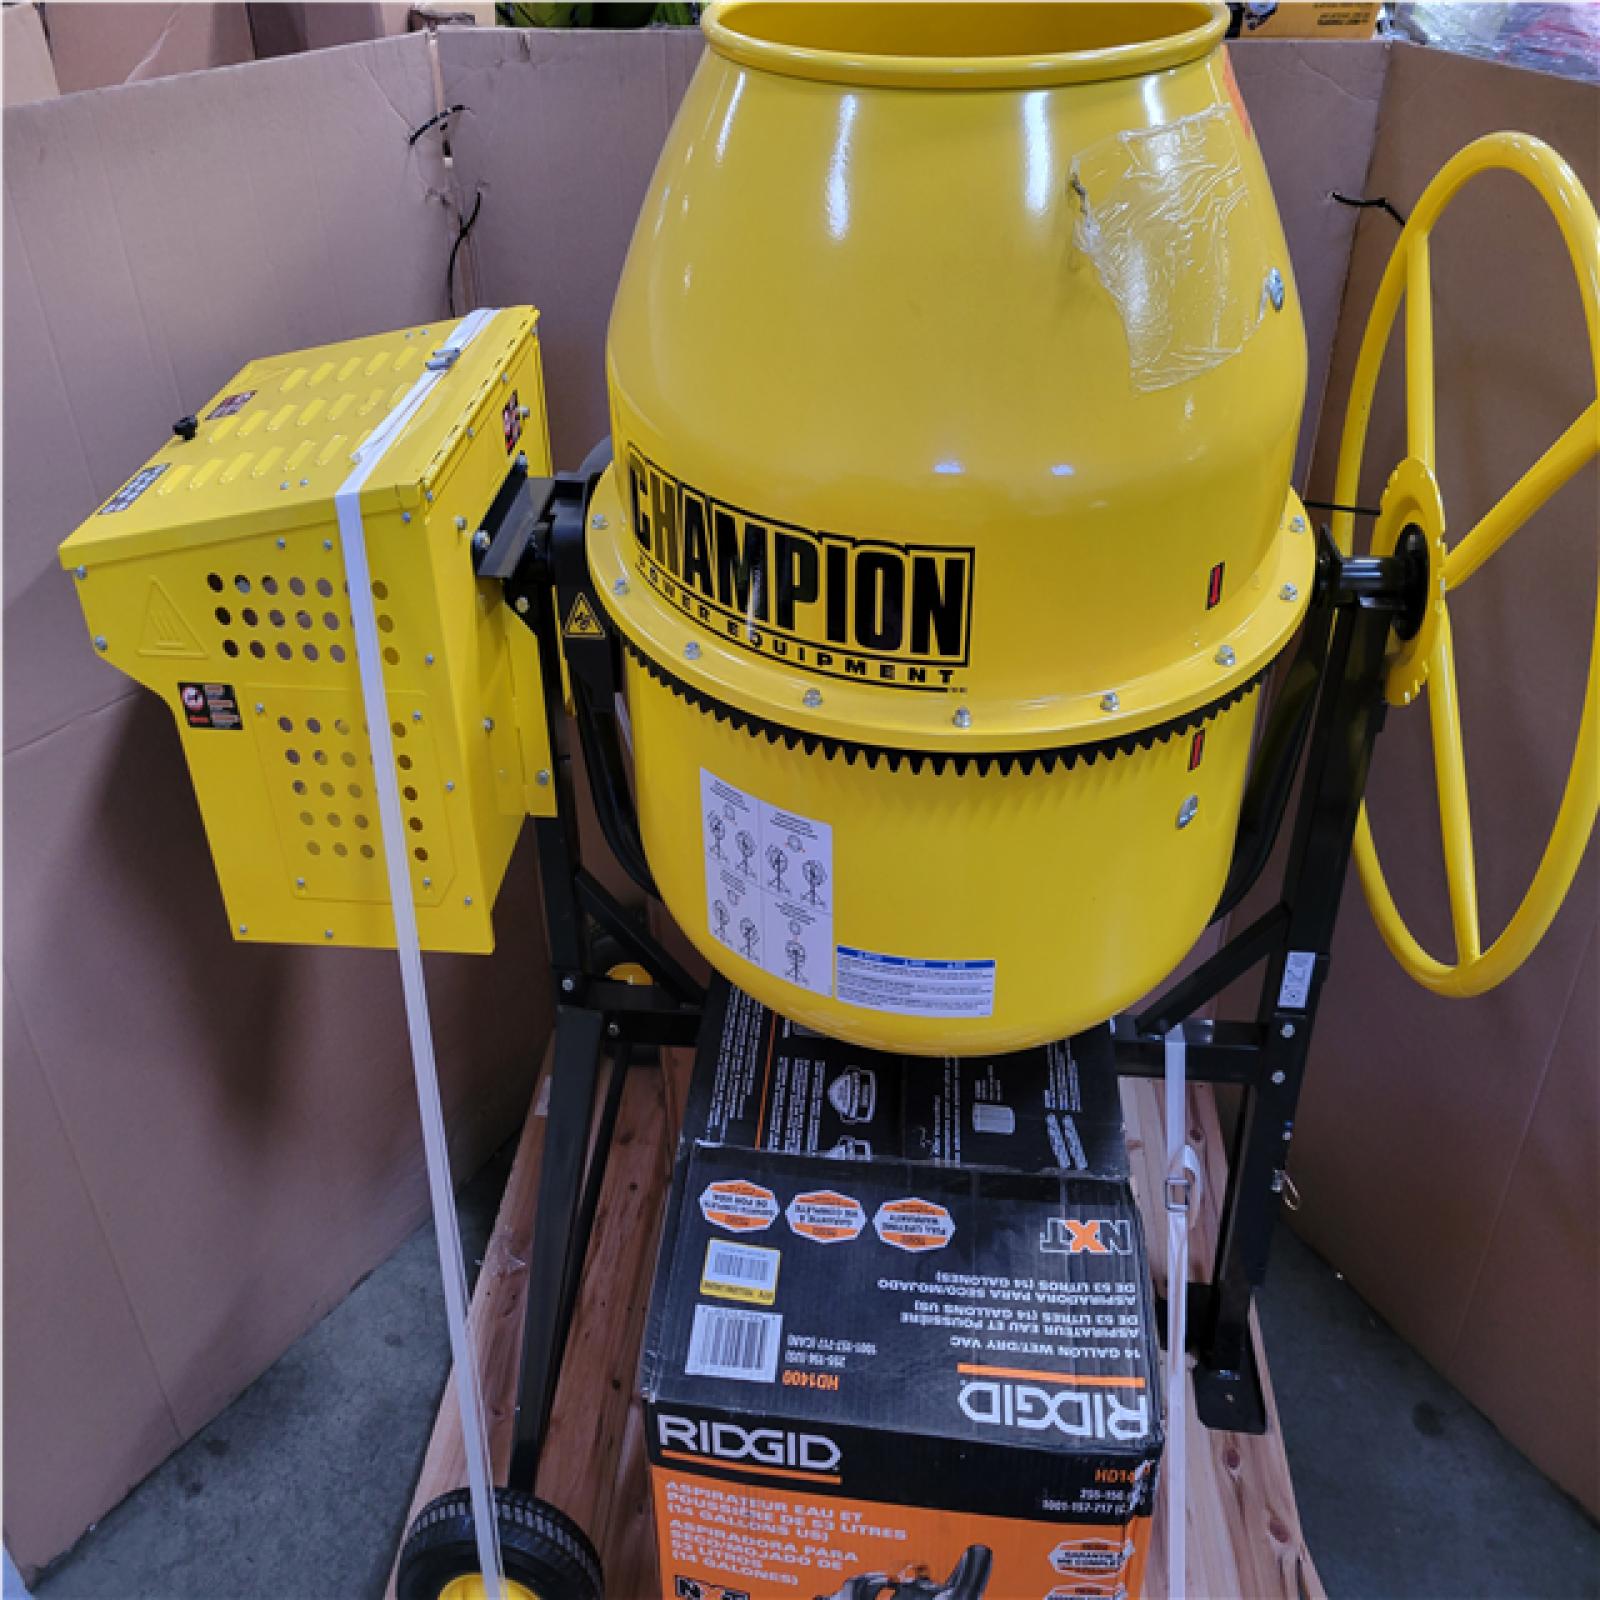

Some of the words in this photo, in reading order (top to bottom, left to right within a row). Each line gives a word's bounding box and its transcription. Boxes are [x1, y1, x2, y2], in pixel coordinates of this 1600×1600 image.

[630, 450, 966, 656] CHAMPION
[727, 619, 953, 683] EQUIPMENT
[1039, 1216, 1134, 1256] NXT
[877, 1278, 986, 1299] SECO/MOJADO
[1038, 1279, 1089, 1292] LITROS
[1114, 1281, 1136, 1292] DE
[989, 1289, 1031, 1302] PARA
[1034, 1291, 1137, 1306] ASPIRADORA
[943, 1303, 1014, 1320] GALLONS
[1042, 1311, 1091, 1325] LITRES
[1116, 1314, 1139, 1325] DE
[1009, 1321, 1039, 1334] EAU
[1043, 1323, 1141, 1339] ASPIRATEUR
[949, 1335, 981, 1348] VAC
[986, 1338, 1054, 1356] WET/DRY
[1058, 1345, 1121, 1359] GALLON
[1124, 1348, 1141, 1360] 14
[781, 1369, 840, 1391] HD1400
[957, 1380, 1150, 1441] RIDGID
[657, 1414, 841, 1470] RIDGID
[665, 1480, 788, 1513] ASPIRATEUR
[794, 1504, 834, 1519] EAU
[839, 1510, 863, 1522] ET
[698, 1509, 791, 1536] GALLONS
[780, 1513, 806, 1527] DE
[839, 1522, 908, 1541] LITRES
[669, 1519, 797, 1552] ASPIRADORA
[803, 1543, 858, 1562] PARA
[698, 1546, 763, 1569] LITROS
[817, 1558, 843, 1571] DE
